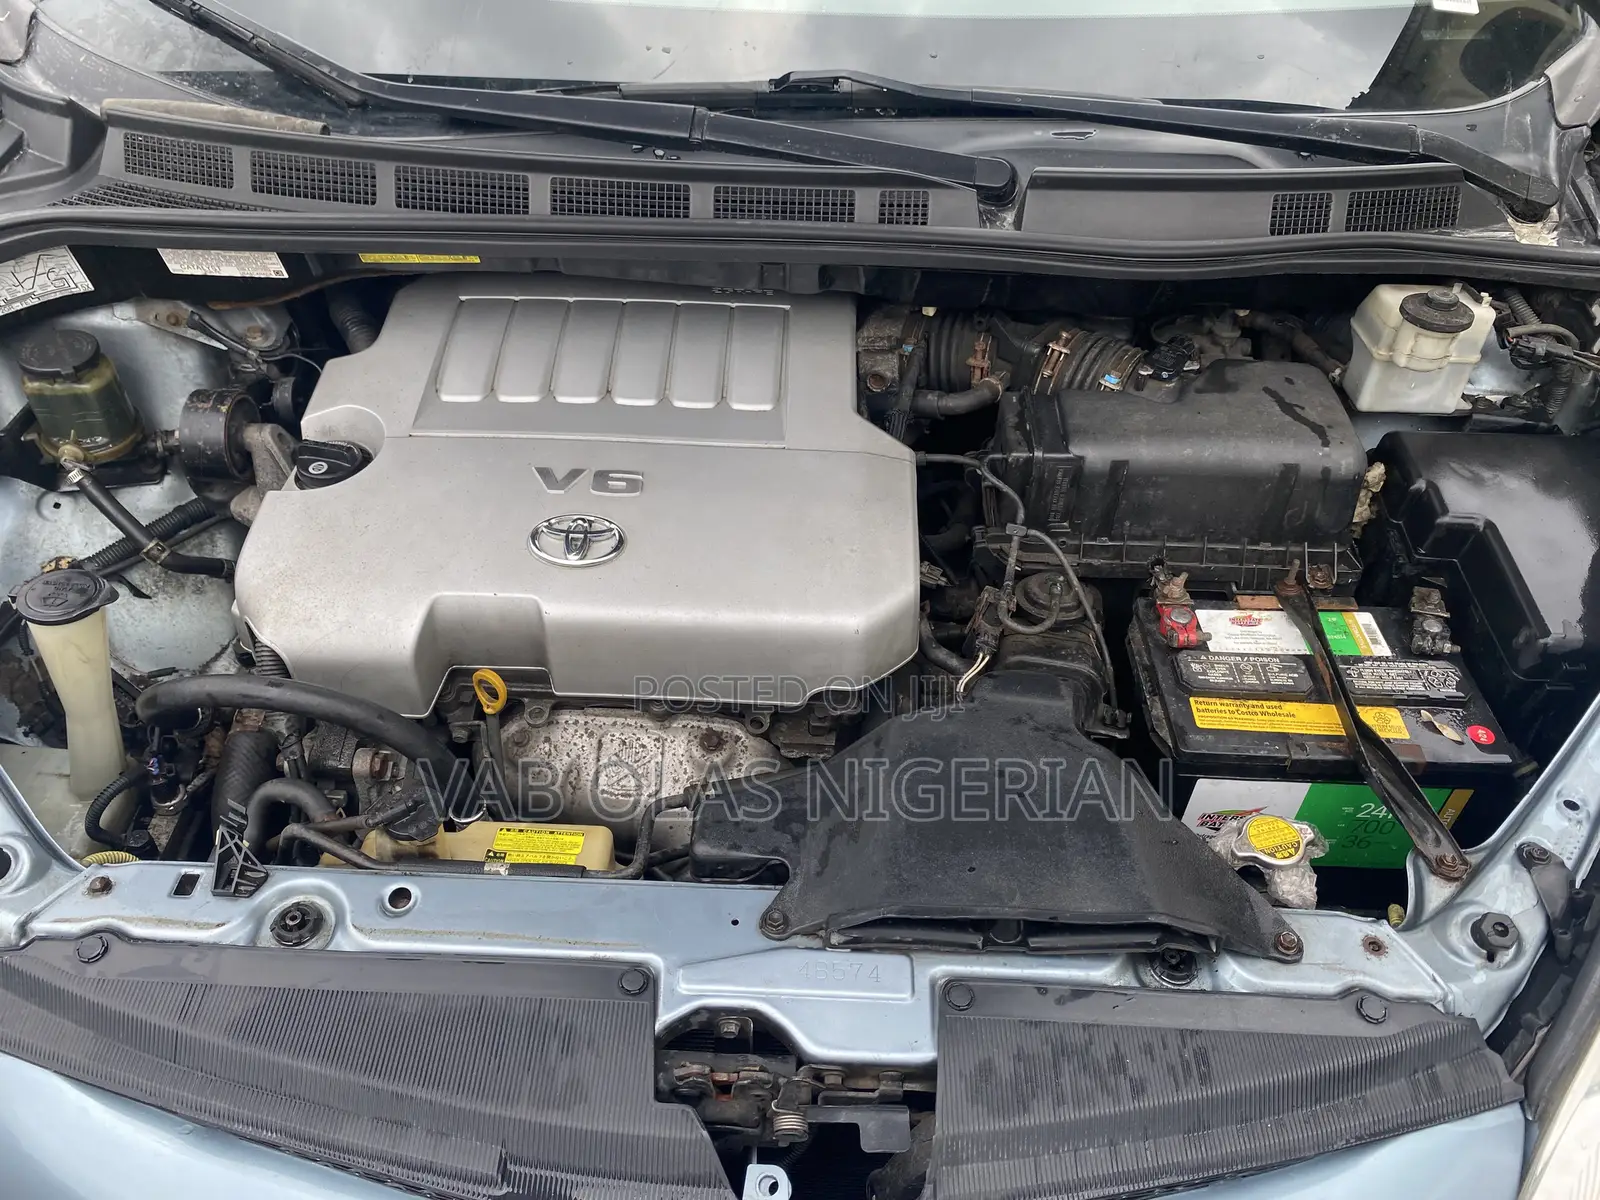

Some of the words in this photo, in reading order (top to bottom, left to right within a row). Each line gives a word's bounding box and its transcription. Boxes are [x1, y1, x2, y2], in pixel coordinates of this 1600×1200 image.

[532, 466, 643, 497] V6
[1219, 702, 1250, 710] warranty
[1349, 819, 1396, 835] 700
[1264, 842, 1298, 854] CAUTION
[1342, 835, 1373, 849] 36
